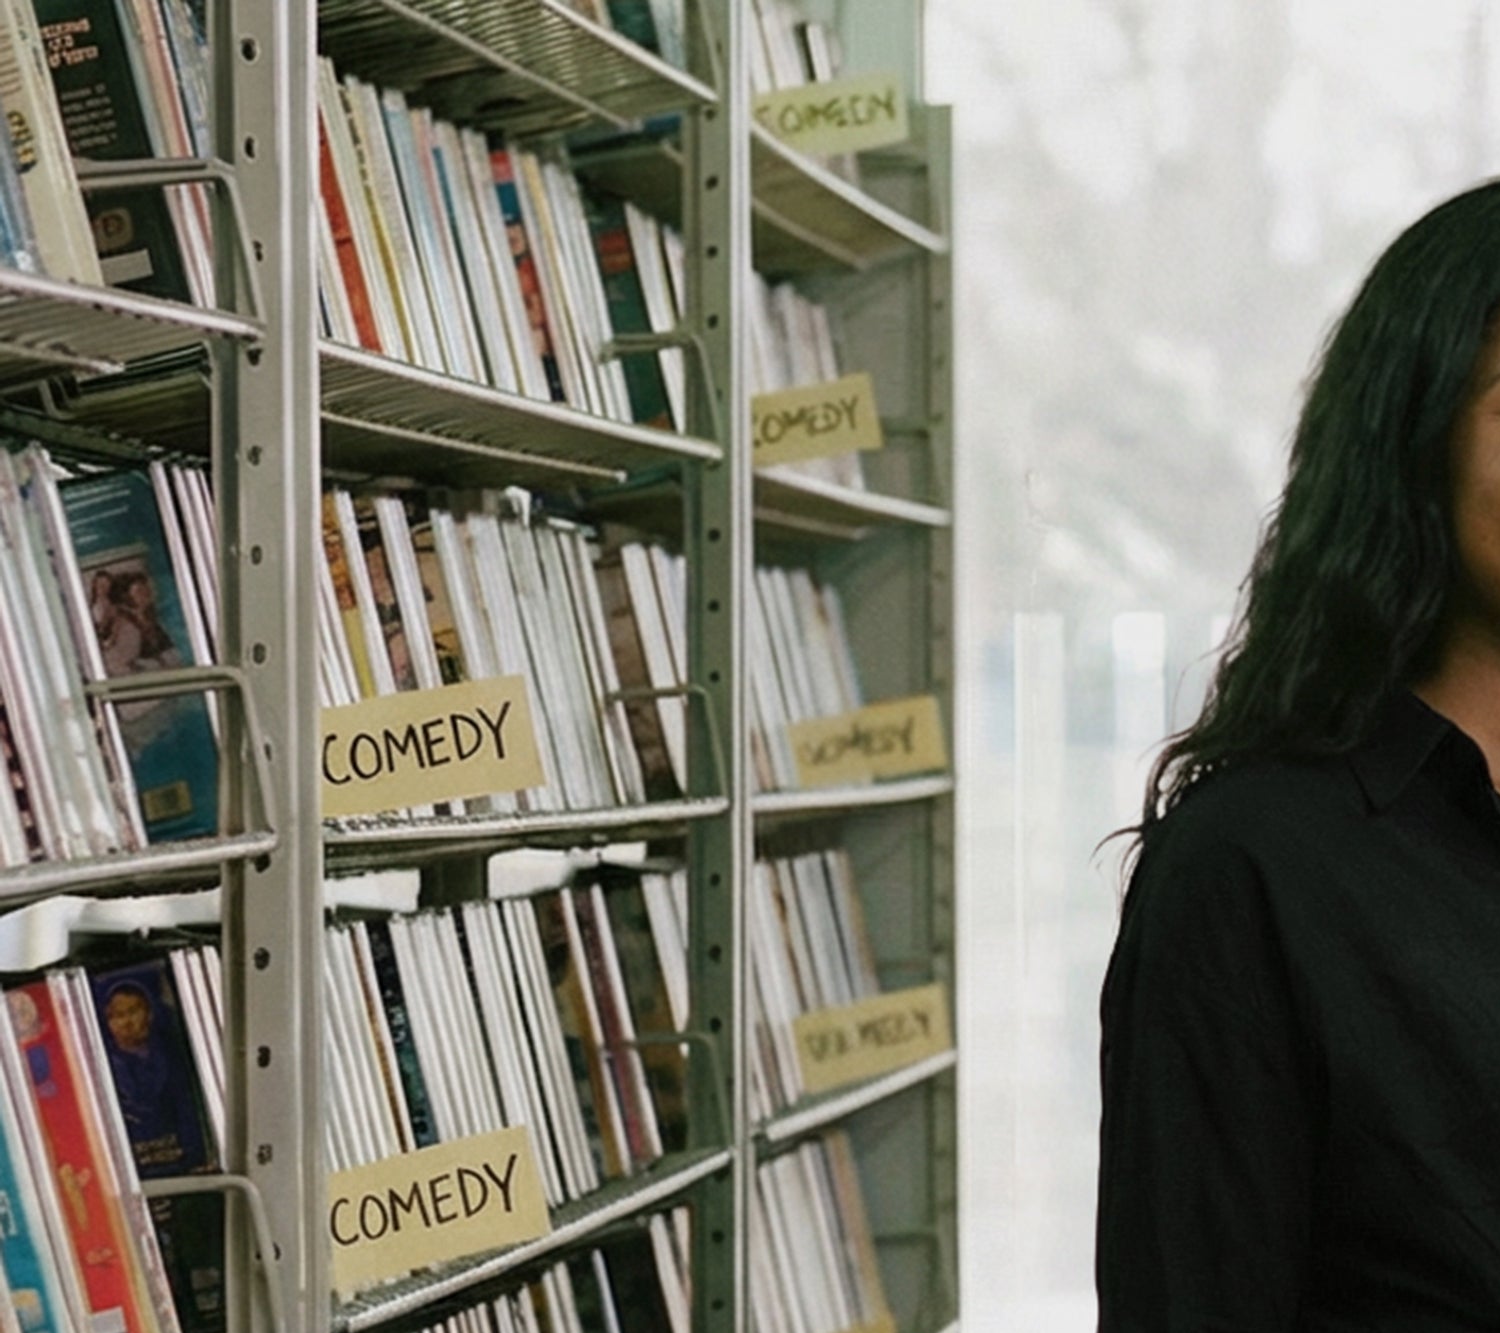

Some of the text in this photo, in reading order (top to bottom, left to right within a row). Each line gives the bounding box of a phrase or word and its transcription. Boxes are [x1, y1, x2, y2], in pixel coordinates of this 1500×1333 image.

[753, 395, 858, 448] OMEDY
[322, 701, 511, 785] COMEDY
[330, 1154, 517, 1246] COMEDY
